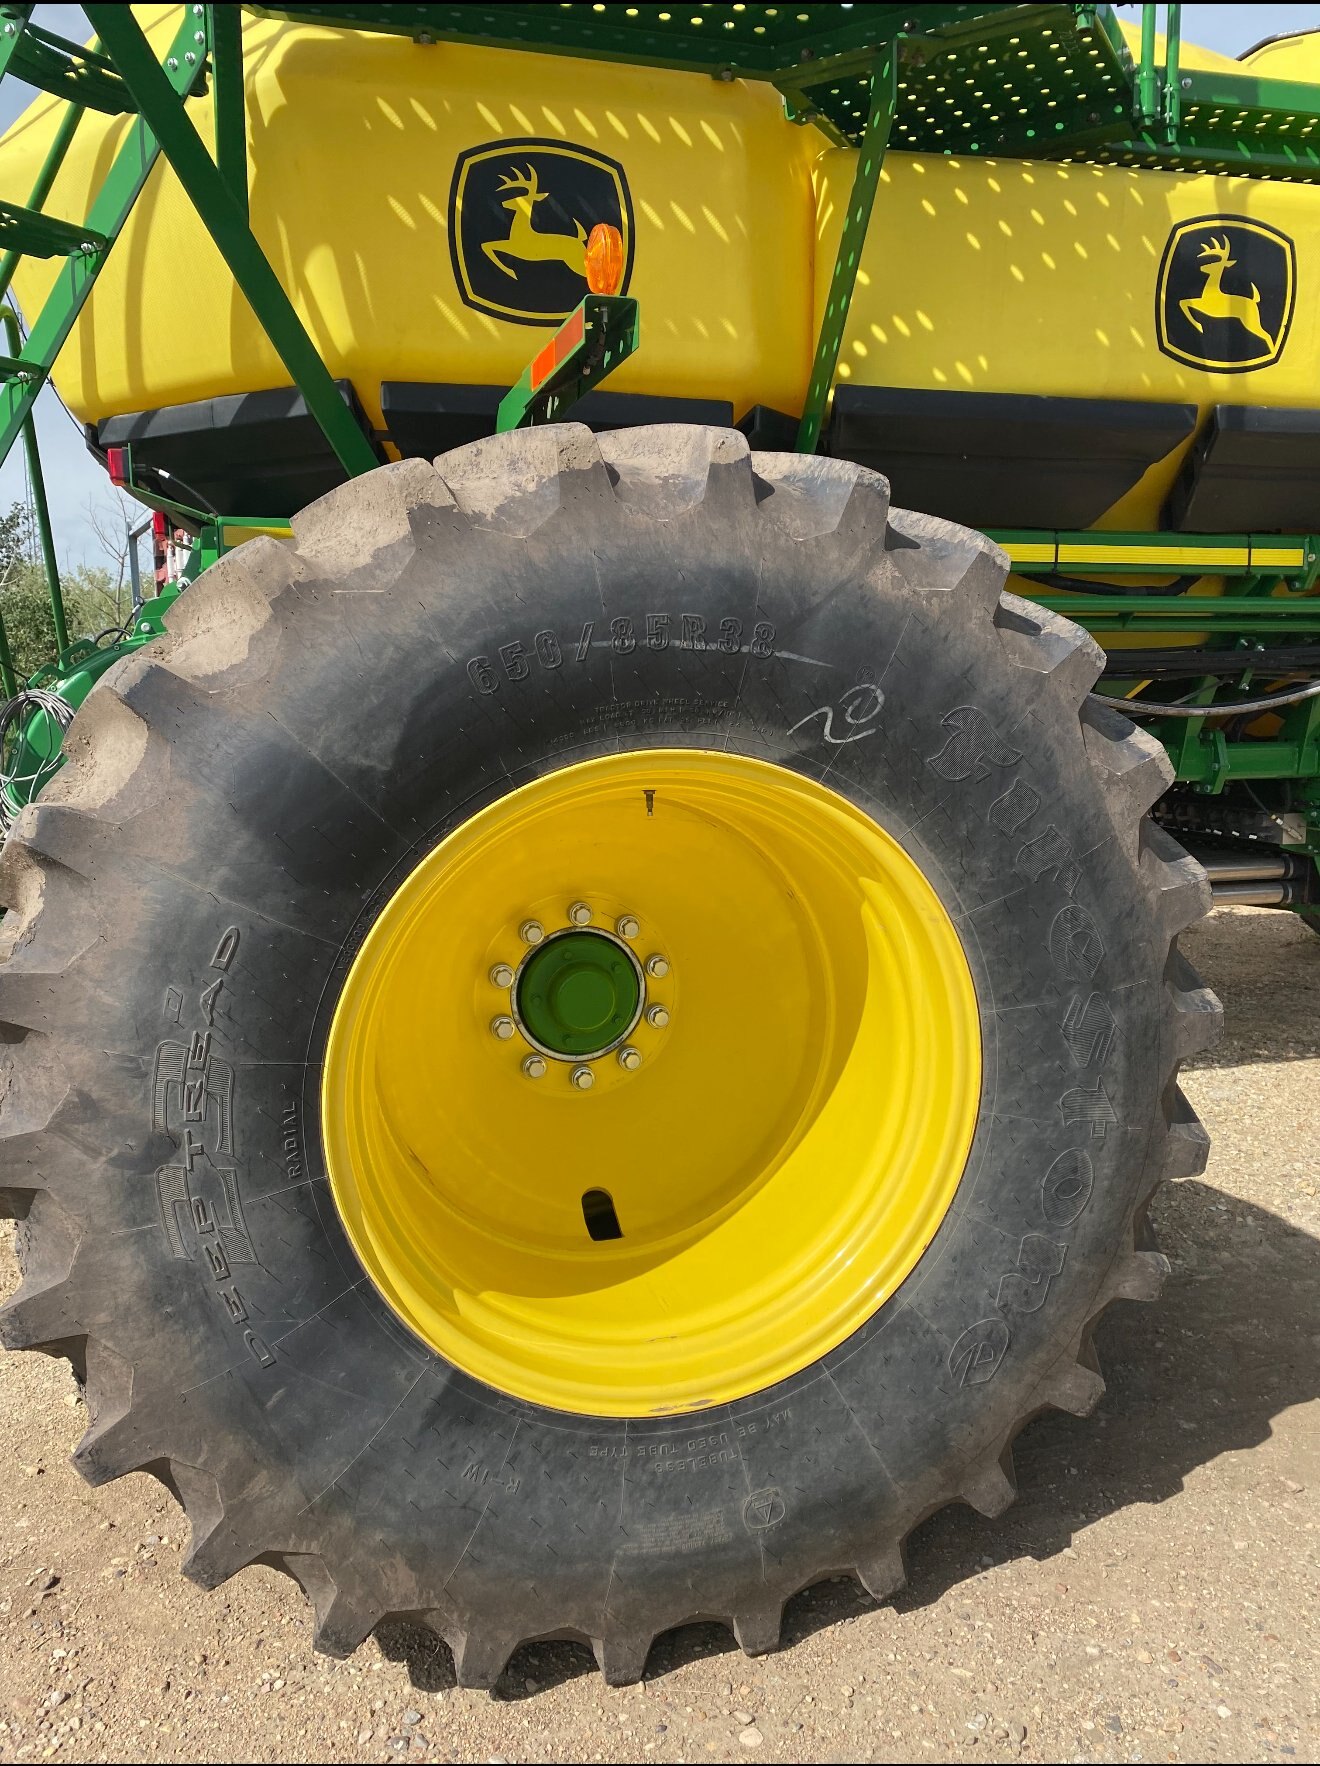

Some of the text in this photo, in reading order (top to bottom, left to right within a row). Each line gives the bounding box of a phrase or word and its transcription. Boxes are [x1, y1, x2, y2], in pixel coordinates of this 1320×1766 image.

[466, 612, 777, 696] 650/85R38
[183, 924, 277, 1371] DEEP TREAD
[280, 1099, 302, 1180] RADIAL
[588, 1407, 793, 1459] MAY BE USED TUBE TYPE
[653, 1449, 739, 1475] TUBELESS
